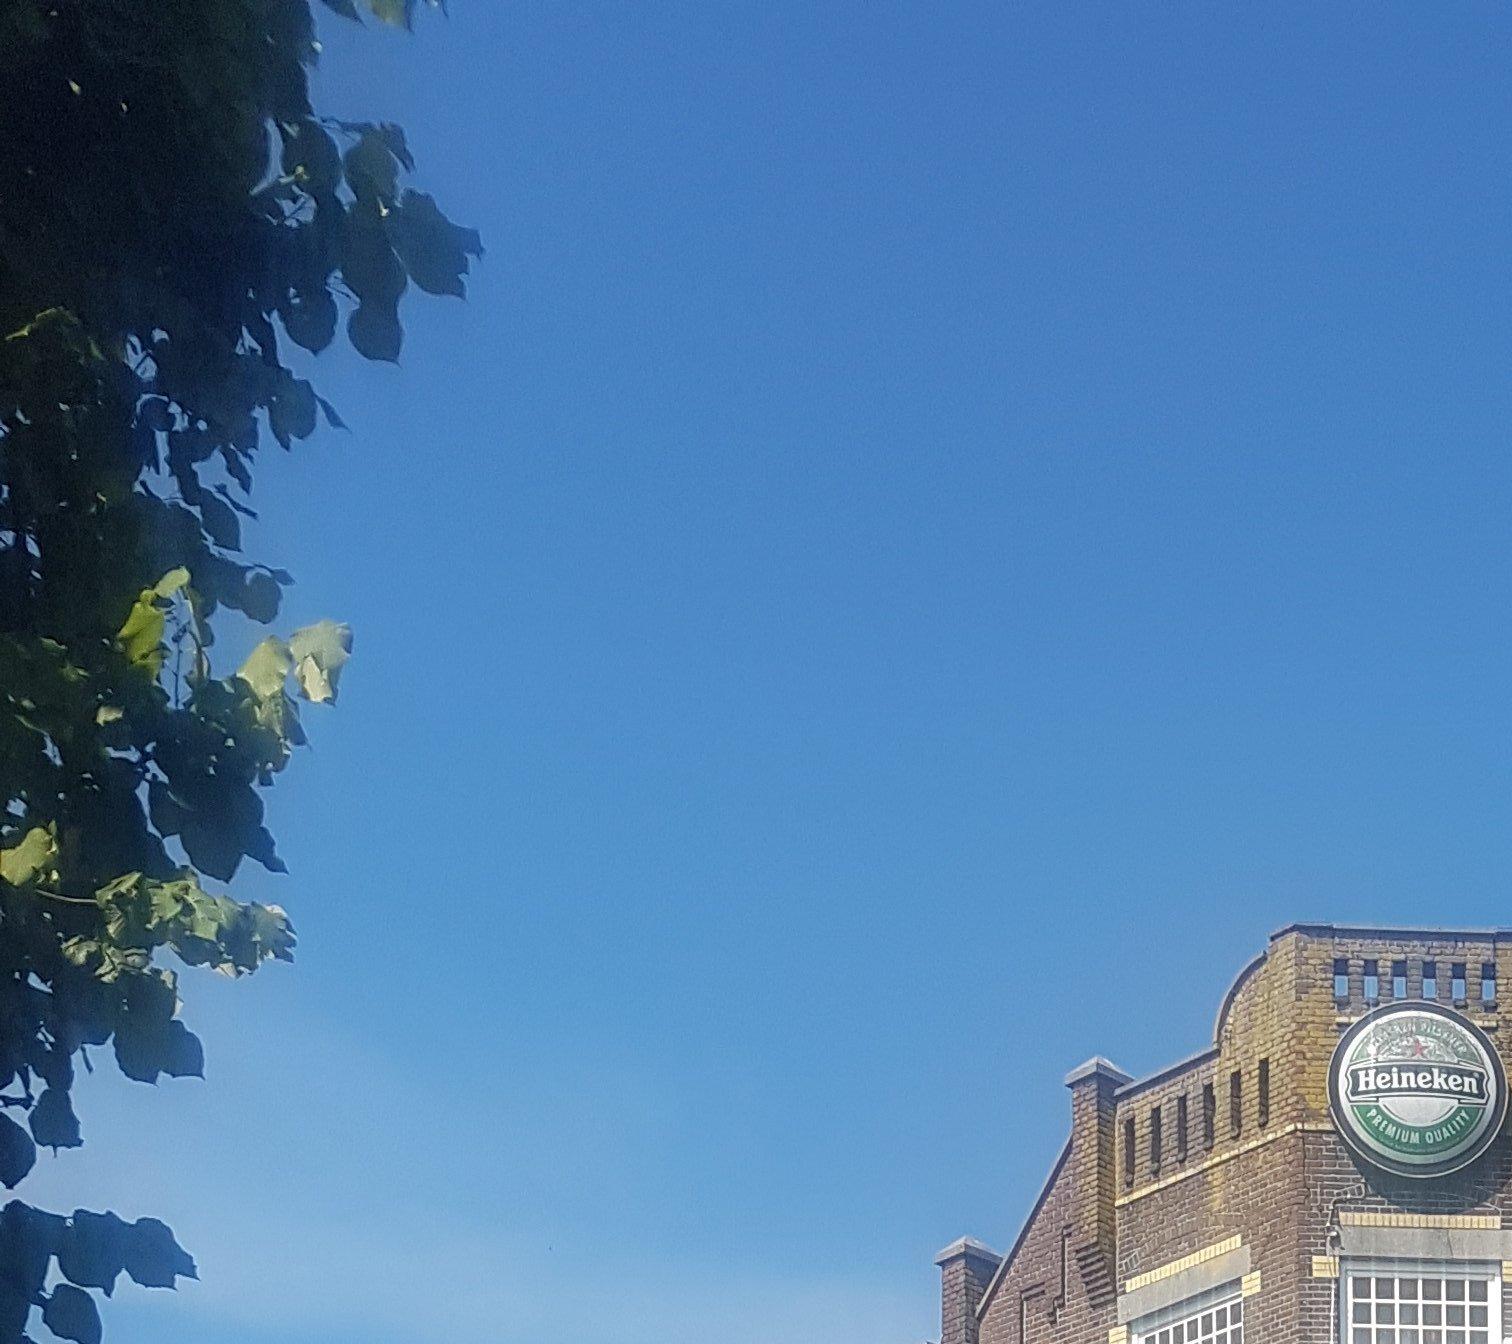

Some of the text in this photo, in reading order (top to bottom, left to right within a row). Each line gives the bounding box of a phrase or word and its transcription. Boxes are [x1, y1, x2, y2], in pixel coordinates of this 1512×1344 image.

[1357, 1066, 1479, 1095] Heineken
[1366, 1108, 1471, 1144] PREMIUM QUALITY
